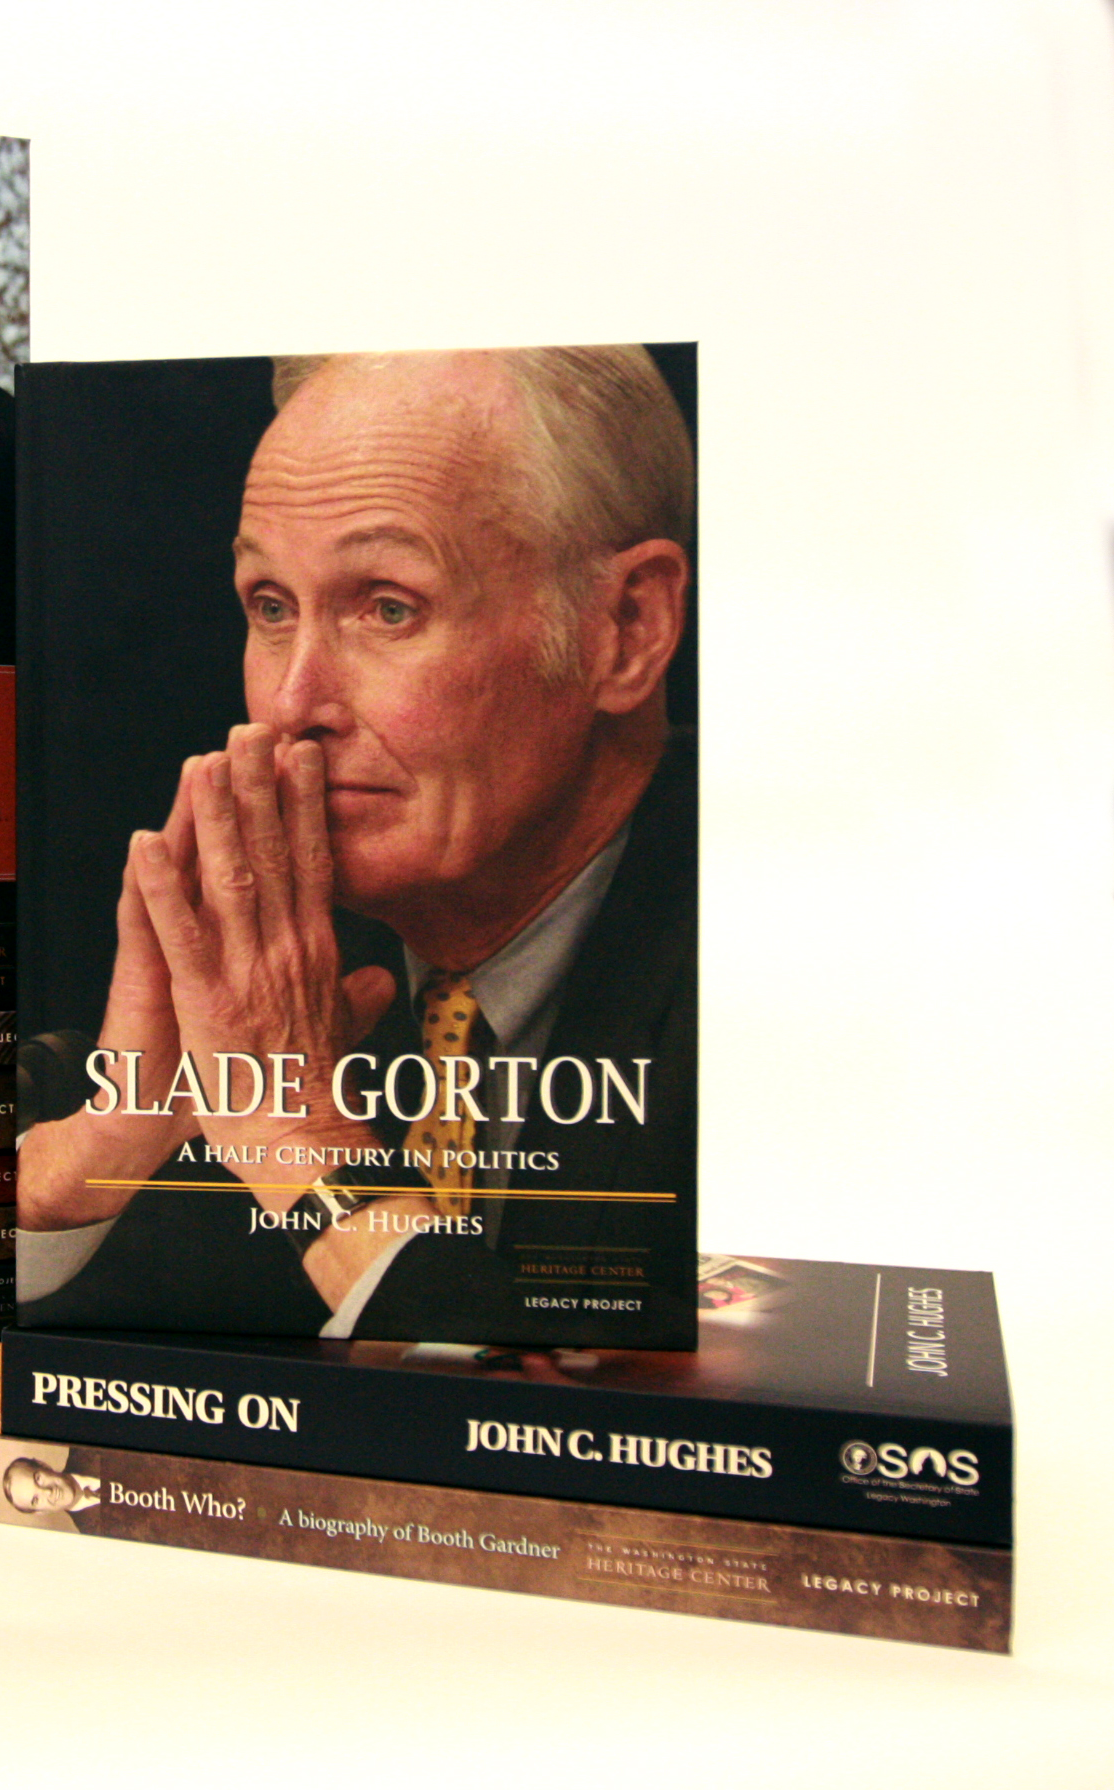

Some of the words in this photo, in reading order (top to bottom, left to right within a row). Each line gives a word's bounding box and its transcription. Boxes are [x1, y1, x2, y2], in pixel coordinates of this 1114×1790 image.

[84, 1049, 308, 1118] SLADE
[331, 1053, 652, 1126] GORTON
[177, 1142, 197, 1163] A
[204, 1145, 269, 1165] HALF
[275, 1145, 395, 1168] CENTURY
[403, 1149, 433, 1168] IN
[441, 1150, 560, 1171] POLITICS
[248, 1206, 322, 1235] JOHN
[330, 1210, 358, 1232] C.
[368, 1210, 484, 1236] HUGHES
[520, 1264, 587, 1276] HERITAGE
[591, 1265, 645, 1278] CENTER
[525, 1296, 580, 1311] LEGACY
[584, 1298, 643, 1312] PROJECT
[907, 1286, 944, 1328] HUGHES
[906, 1340, 948, 1377] JOHN
[31, 1371, 226, 1425] PRESSING
[237, 1393, 301, 1433] ON
[465, 1418, 565, 1458] JOHN
[567, 1429, 604, 1462] C.
[609, 1433, 774, 1479] HUGHES
[109, 1482, 176, 1512] Booth
[181, 1490, 246, 1521] Who?
[278, 1509, 294, 1527] A
[297, 1510, 388, 1544] biography
[392, 1521, 415, 1542] of
[417, 1525, 474, 1550] Booth
[479, 1532, 561, 1560] Gardner
[588, 1544, 614, 1555] THE
[621, 1547, 716, 1567] WASHINGTON
[723, 1558, 768, 1572] STATE
[587, 1558, 684, 1583] HERITAGE
[690, 1568, 771, 1594] CENTER
[801, 1573, 882, 1598] LEGACY
[889, 1585, 981, 1608] PROJECT
